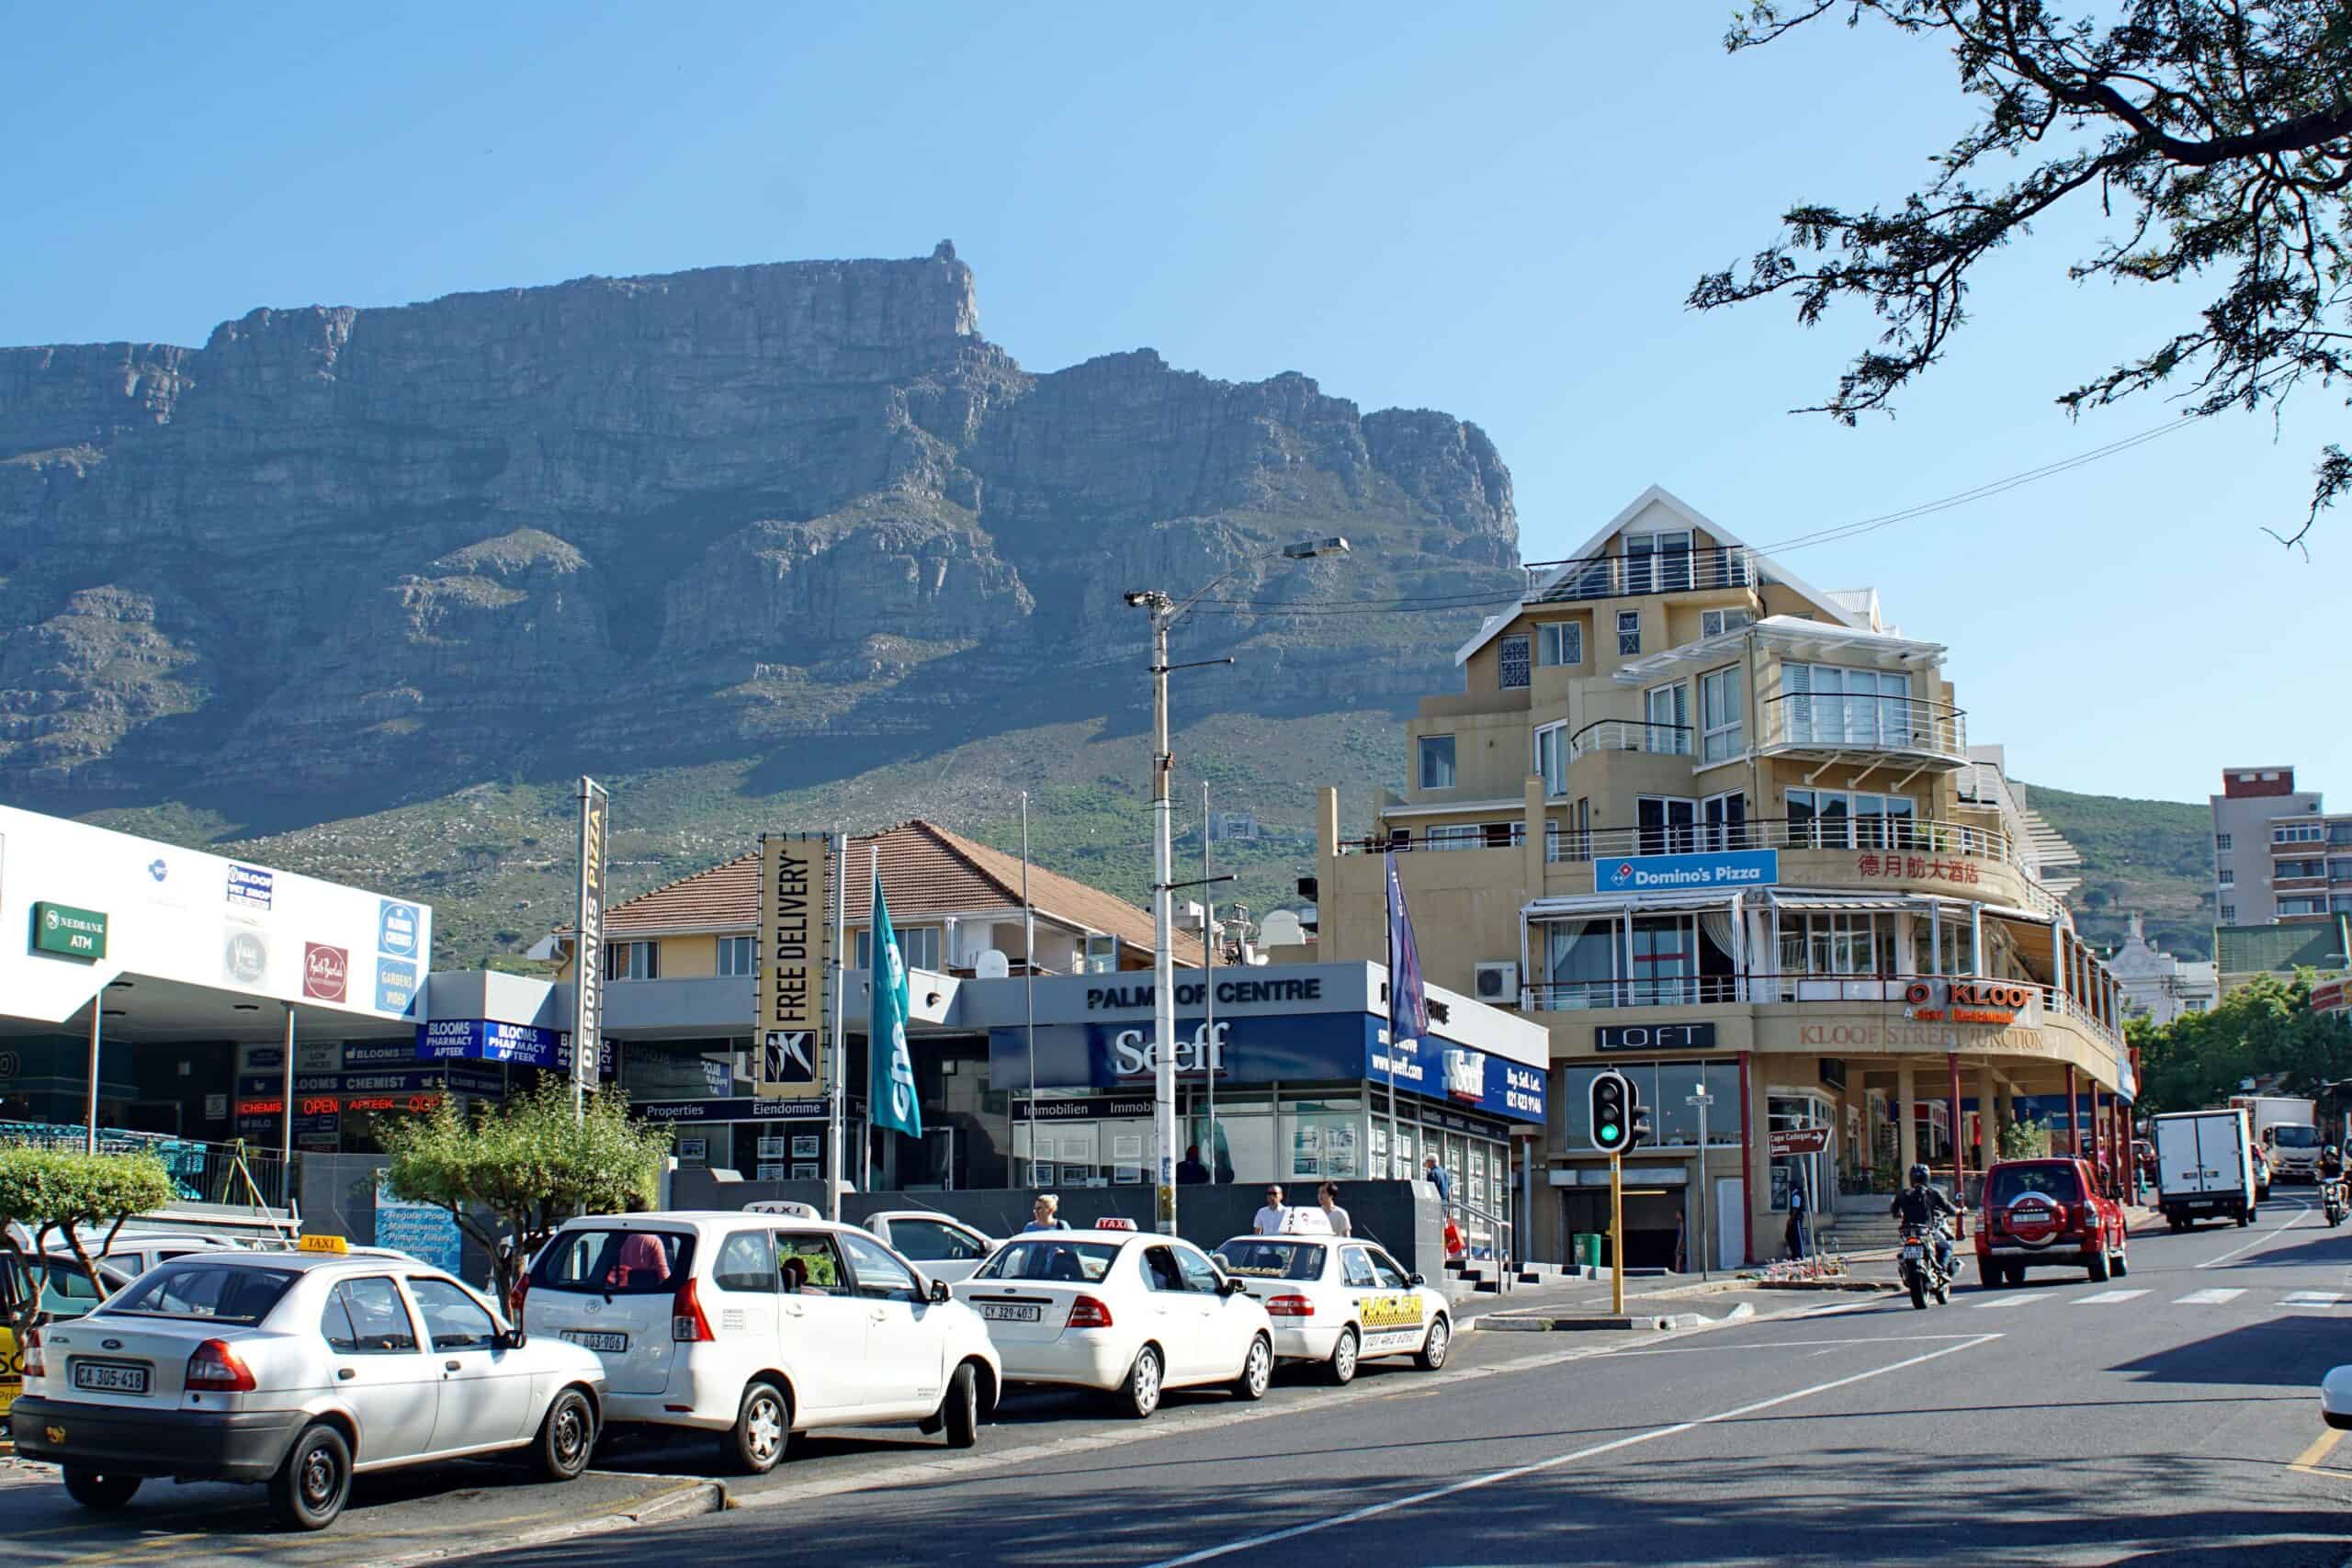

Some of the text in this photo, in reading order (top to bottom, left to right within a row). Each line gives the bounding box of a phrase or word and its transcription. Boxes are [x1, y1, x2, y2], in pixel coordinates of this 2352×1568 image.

[1635, 865, 1760, 885] Domino's Pizza
[59, 917, 104, 933] NEDBANK
[70, 934, 93, 950] ATM
[582, 810, 600, 1068] DEBONAIRS PIZZA
[776, 966, 806, 1021] FREE
[1087, 978, 1321, 1010] PALMOF CENTRE
[1949, 984, 2034, 1008] KLOOF
[428, 1021, 470, 1036] BLOOMS
[498, 1024, 537, 1043] BLOOMS
[1602, 1025, 1704, 1047] LOFT
[426, 1035, 473, 1046] PHARMACY
[488, 1036, 547, 1055] PHARMACY
[1800, 1026, 2044, 1051] KLOOF STREET JUNCTION
[356, 1047, 399, 1058] BLOOMS
[434, 1046, 464, 1057] APTEEK
[1115, 1022, 1230, 1074] Seeff
[1372, 1054, 1423, 1080] wwwseeff.com
[293, 1077, 406, 1090] LOOMS CHEMIST
[242, 1101, 283, 1113] CHEMIS
[303, 1099, 339, 1114] OPEN
[647, 1104, 705, 1118] Properties
[753, 1102, 820, 1116] Eiendomme
[1023, 1103, 1089, 1116] Immobilien
[1110, 1101, 1155, 1113] Immobi
[753, 1205, 801, 1213] TAXI
[1102, 1219, 1129, 1229] TAXI
[308, 1236, 335, 1249] TAXI
[985, 1306, 996, 1317] CY
[79, 1367, 93, 1384] CA
